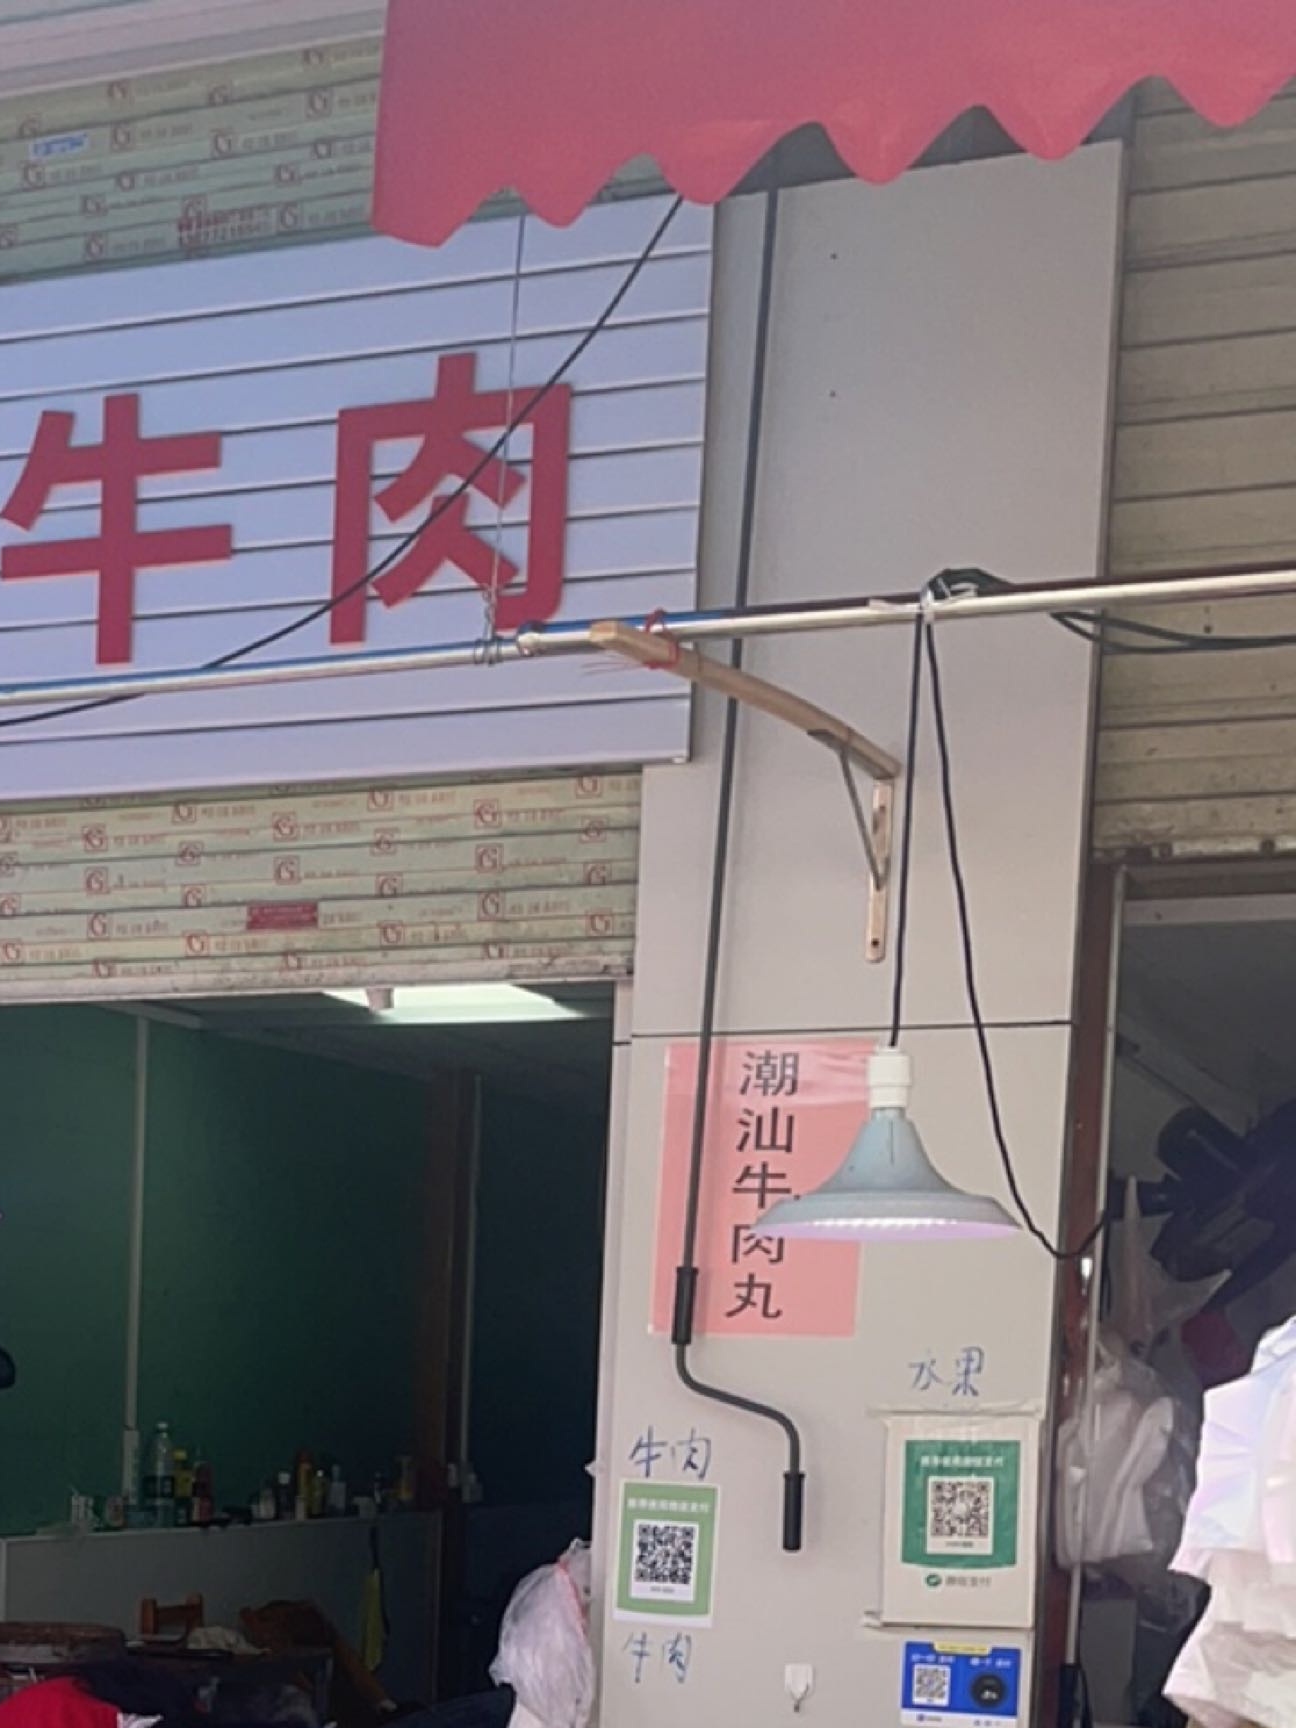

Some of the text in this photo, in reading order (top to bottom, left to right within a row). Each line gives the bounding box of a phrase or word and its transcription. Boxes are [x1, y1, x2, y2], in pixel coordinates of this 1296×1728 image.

[725, 1050, 799, 1319] 潮汕牛肉丸
[907, 1345, 985, 1397] 水果
[628, 1425, 712, 1480] 牛肉
[623, 1630, 693, 1684] 牛肉
